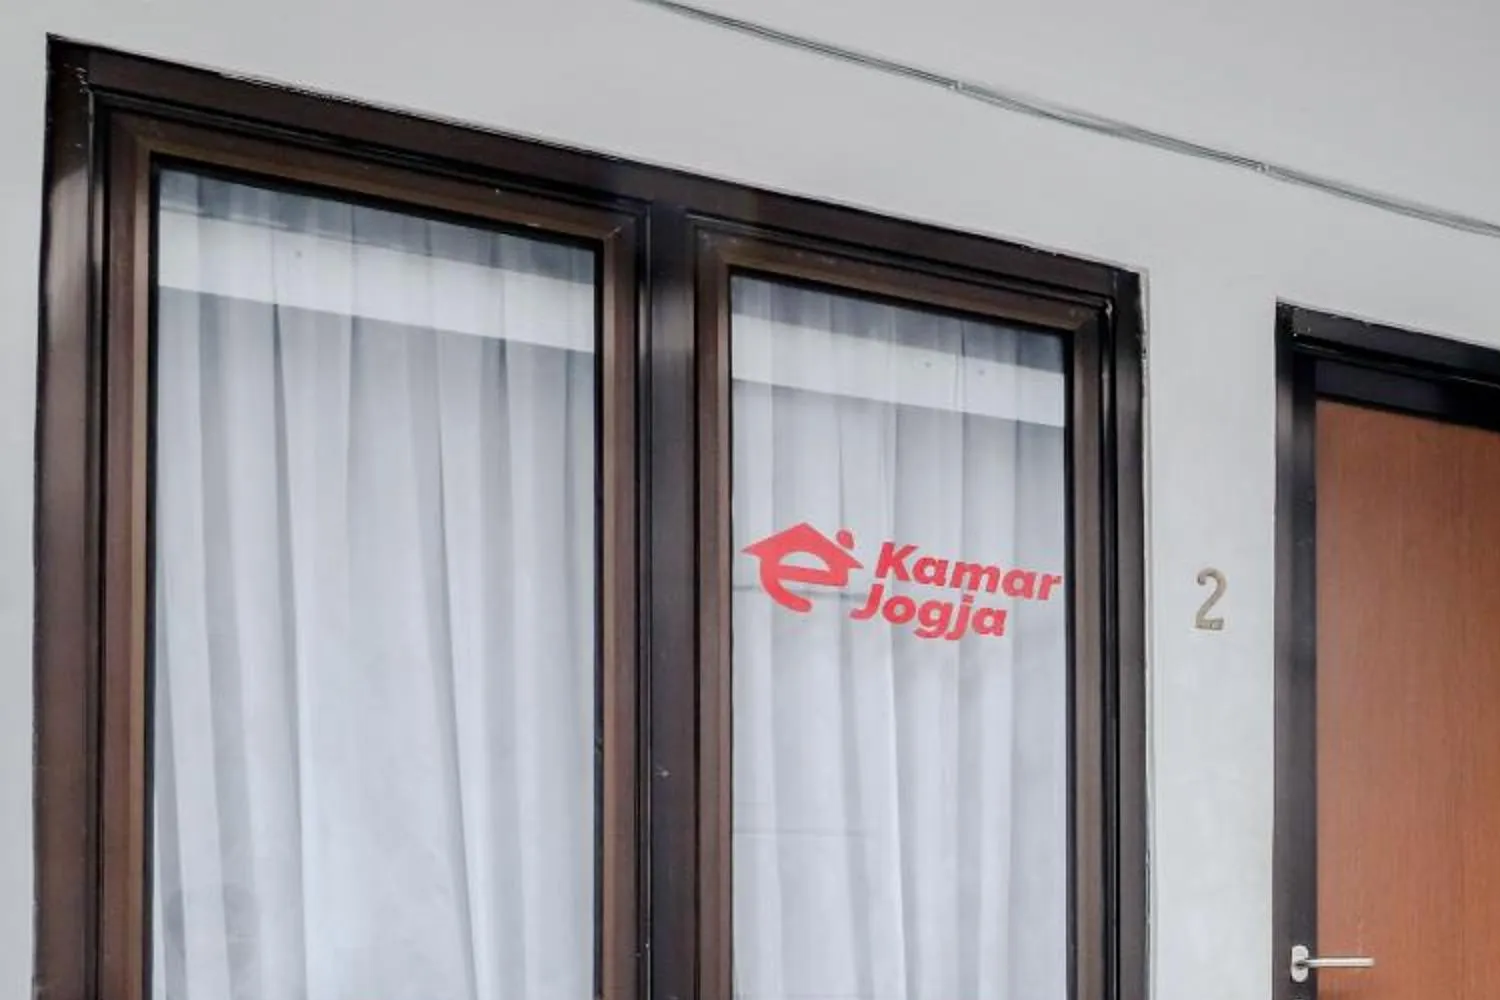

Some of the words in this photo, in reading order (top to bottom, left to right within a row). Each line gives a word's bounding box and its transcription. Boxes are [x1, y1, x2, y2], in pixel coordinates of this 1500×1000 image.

[874, 540, 1062, 601] Kamar
[1194, 567, 1228, 631] 2
[850, 583, 1008, 642] Jogja
